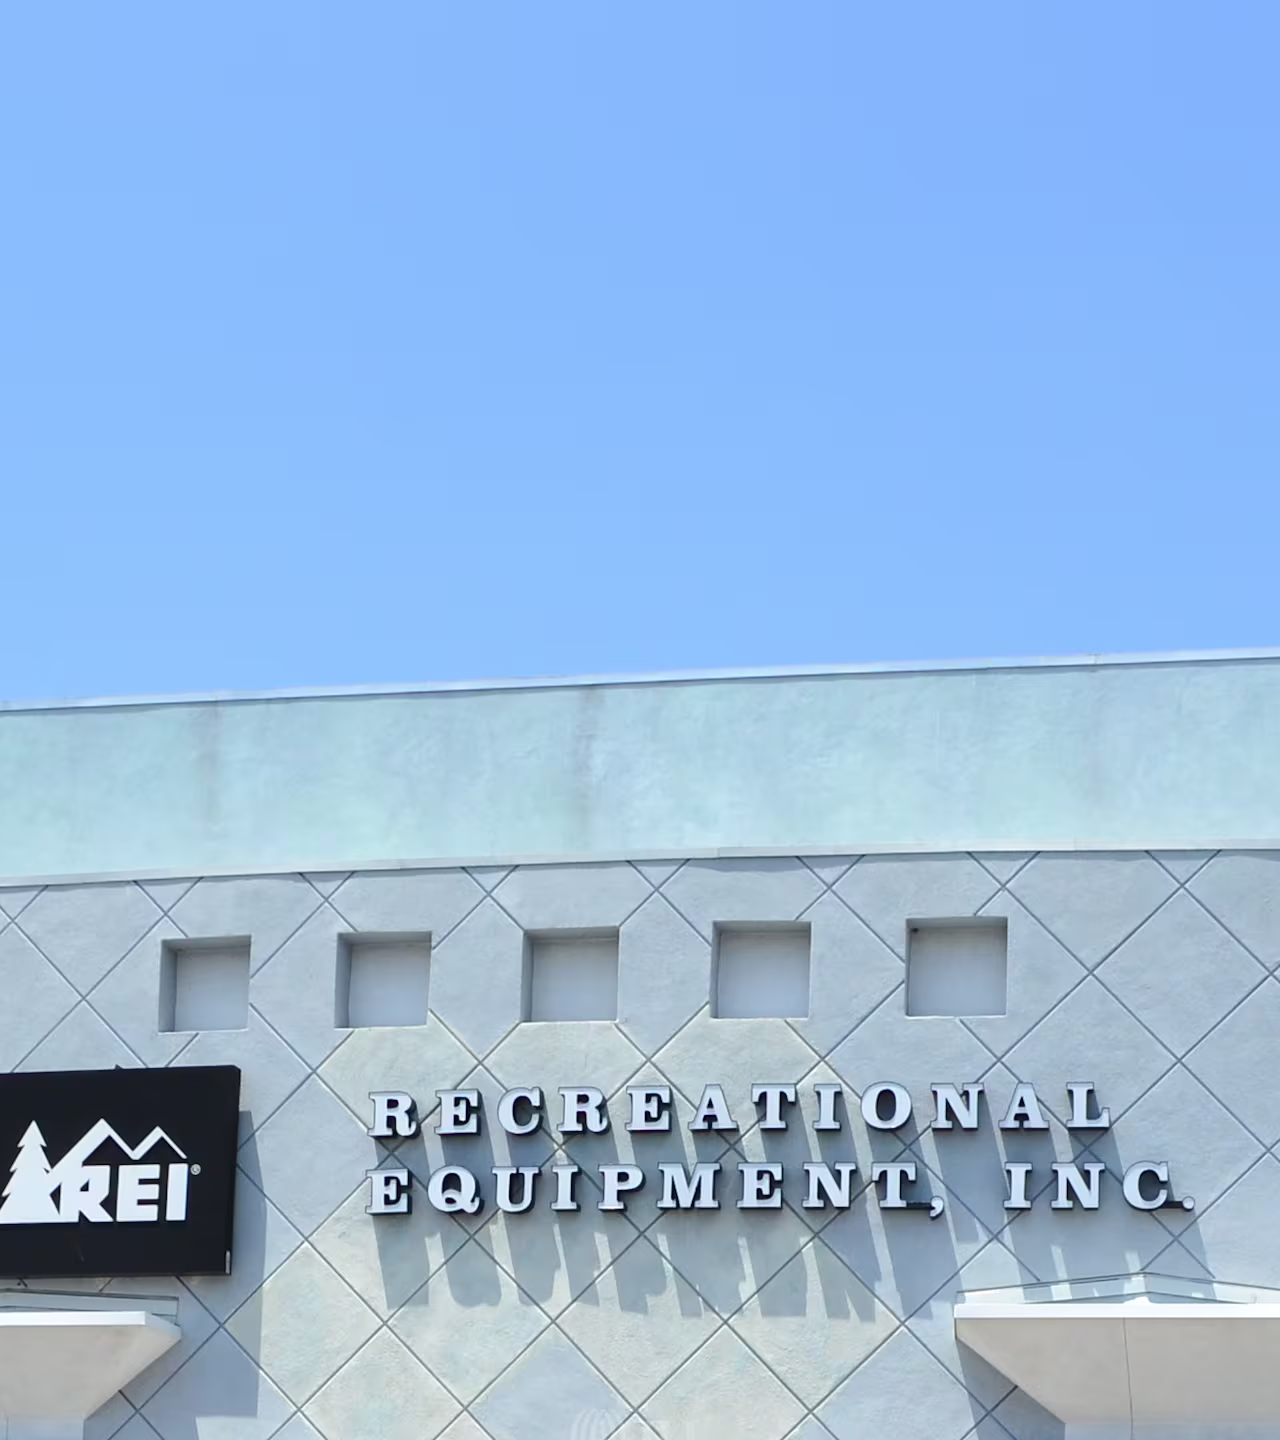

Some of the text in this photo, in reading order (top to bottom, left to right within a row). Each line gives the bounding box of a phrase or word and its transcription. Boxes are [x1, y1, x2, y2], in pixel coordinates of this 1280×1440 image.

[369, 1081, 1111, 1137] RECREATIONAL
[366, 1160, 1195, 1218] EQUIPMENT, INC.
